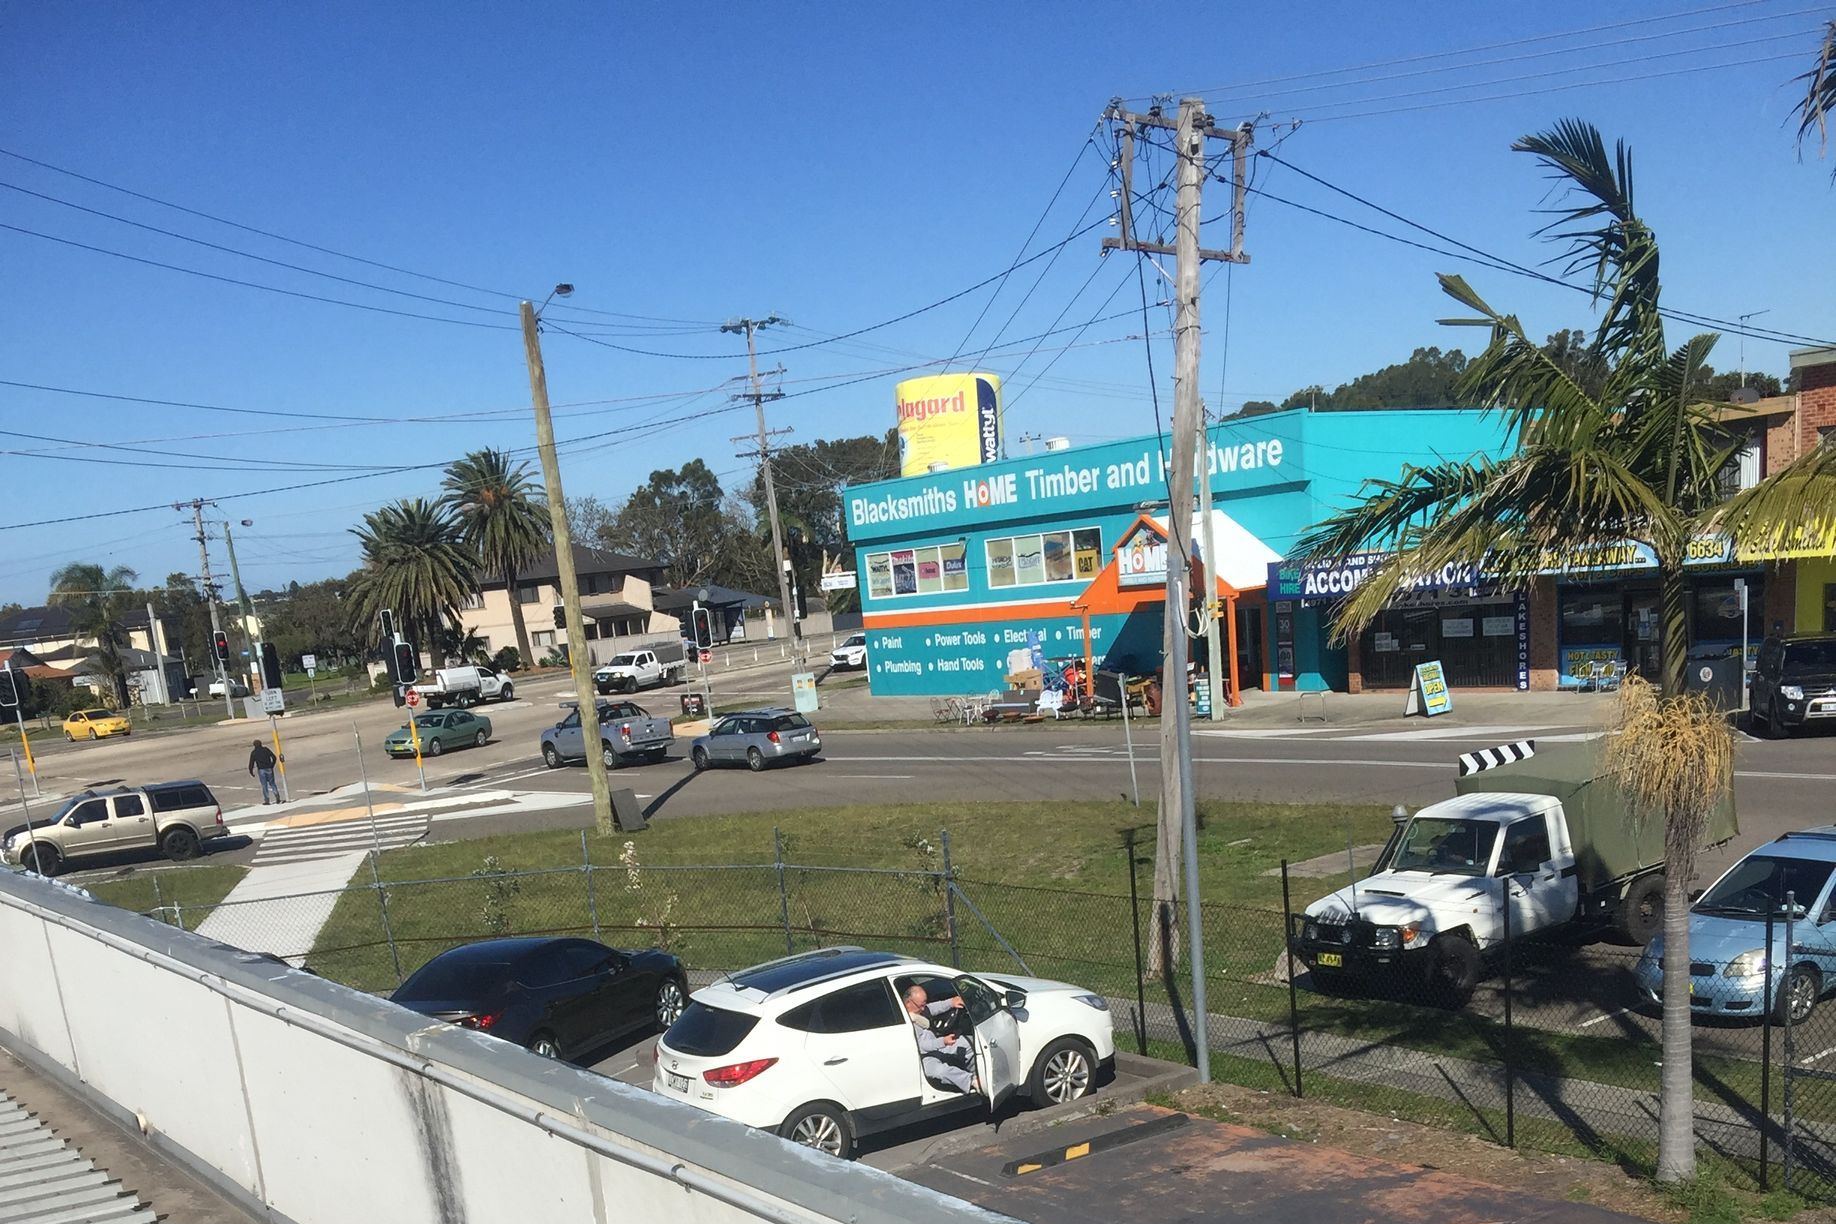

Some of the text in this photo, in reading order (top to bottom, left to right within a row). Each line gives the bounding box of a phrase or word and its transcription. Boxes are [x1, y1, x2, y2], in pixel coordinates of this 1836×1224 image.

[852, 438, 1284, 526] Blacksmiths HOME Timber and Hdware
[1689, 540, 1724, 559] 6634
[1078, 557, 1094, 573] CAT
[1279, 568, 1300, 581] BIKE
[1305, 560, 1471, 595] ACCOMATION
[1280, 583, 1300, 594] HIRE
[935, 631, 986, 647] Power Tools
[1004, 627, 1047, 643] Electal
[1066, 625, 1102, 640] Timer
[882, 636, 903, 649] Paint
[1517, 593, 1528, 690] LAKESHORES
[885, 660, 922, 675] Plumbing
[937, 657, 984, 671] Hand Tools
[1424, 681, 1445, 696] OPEN
